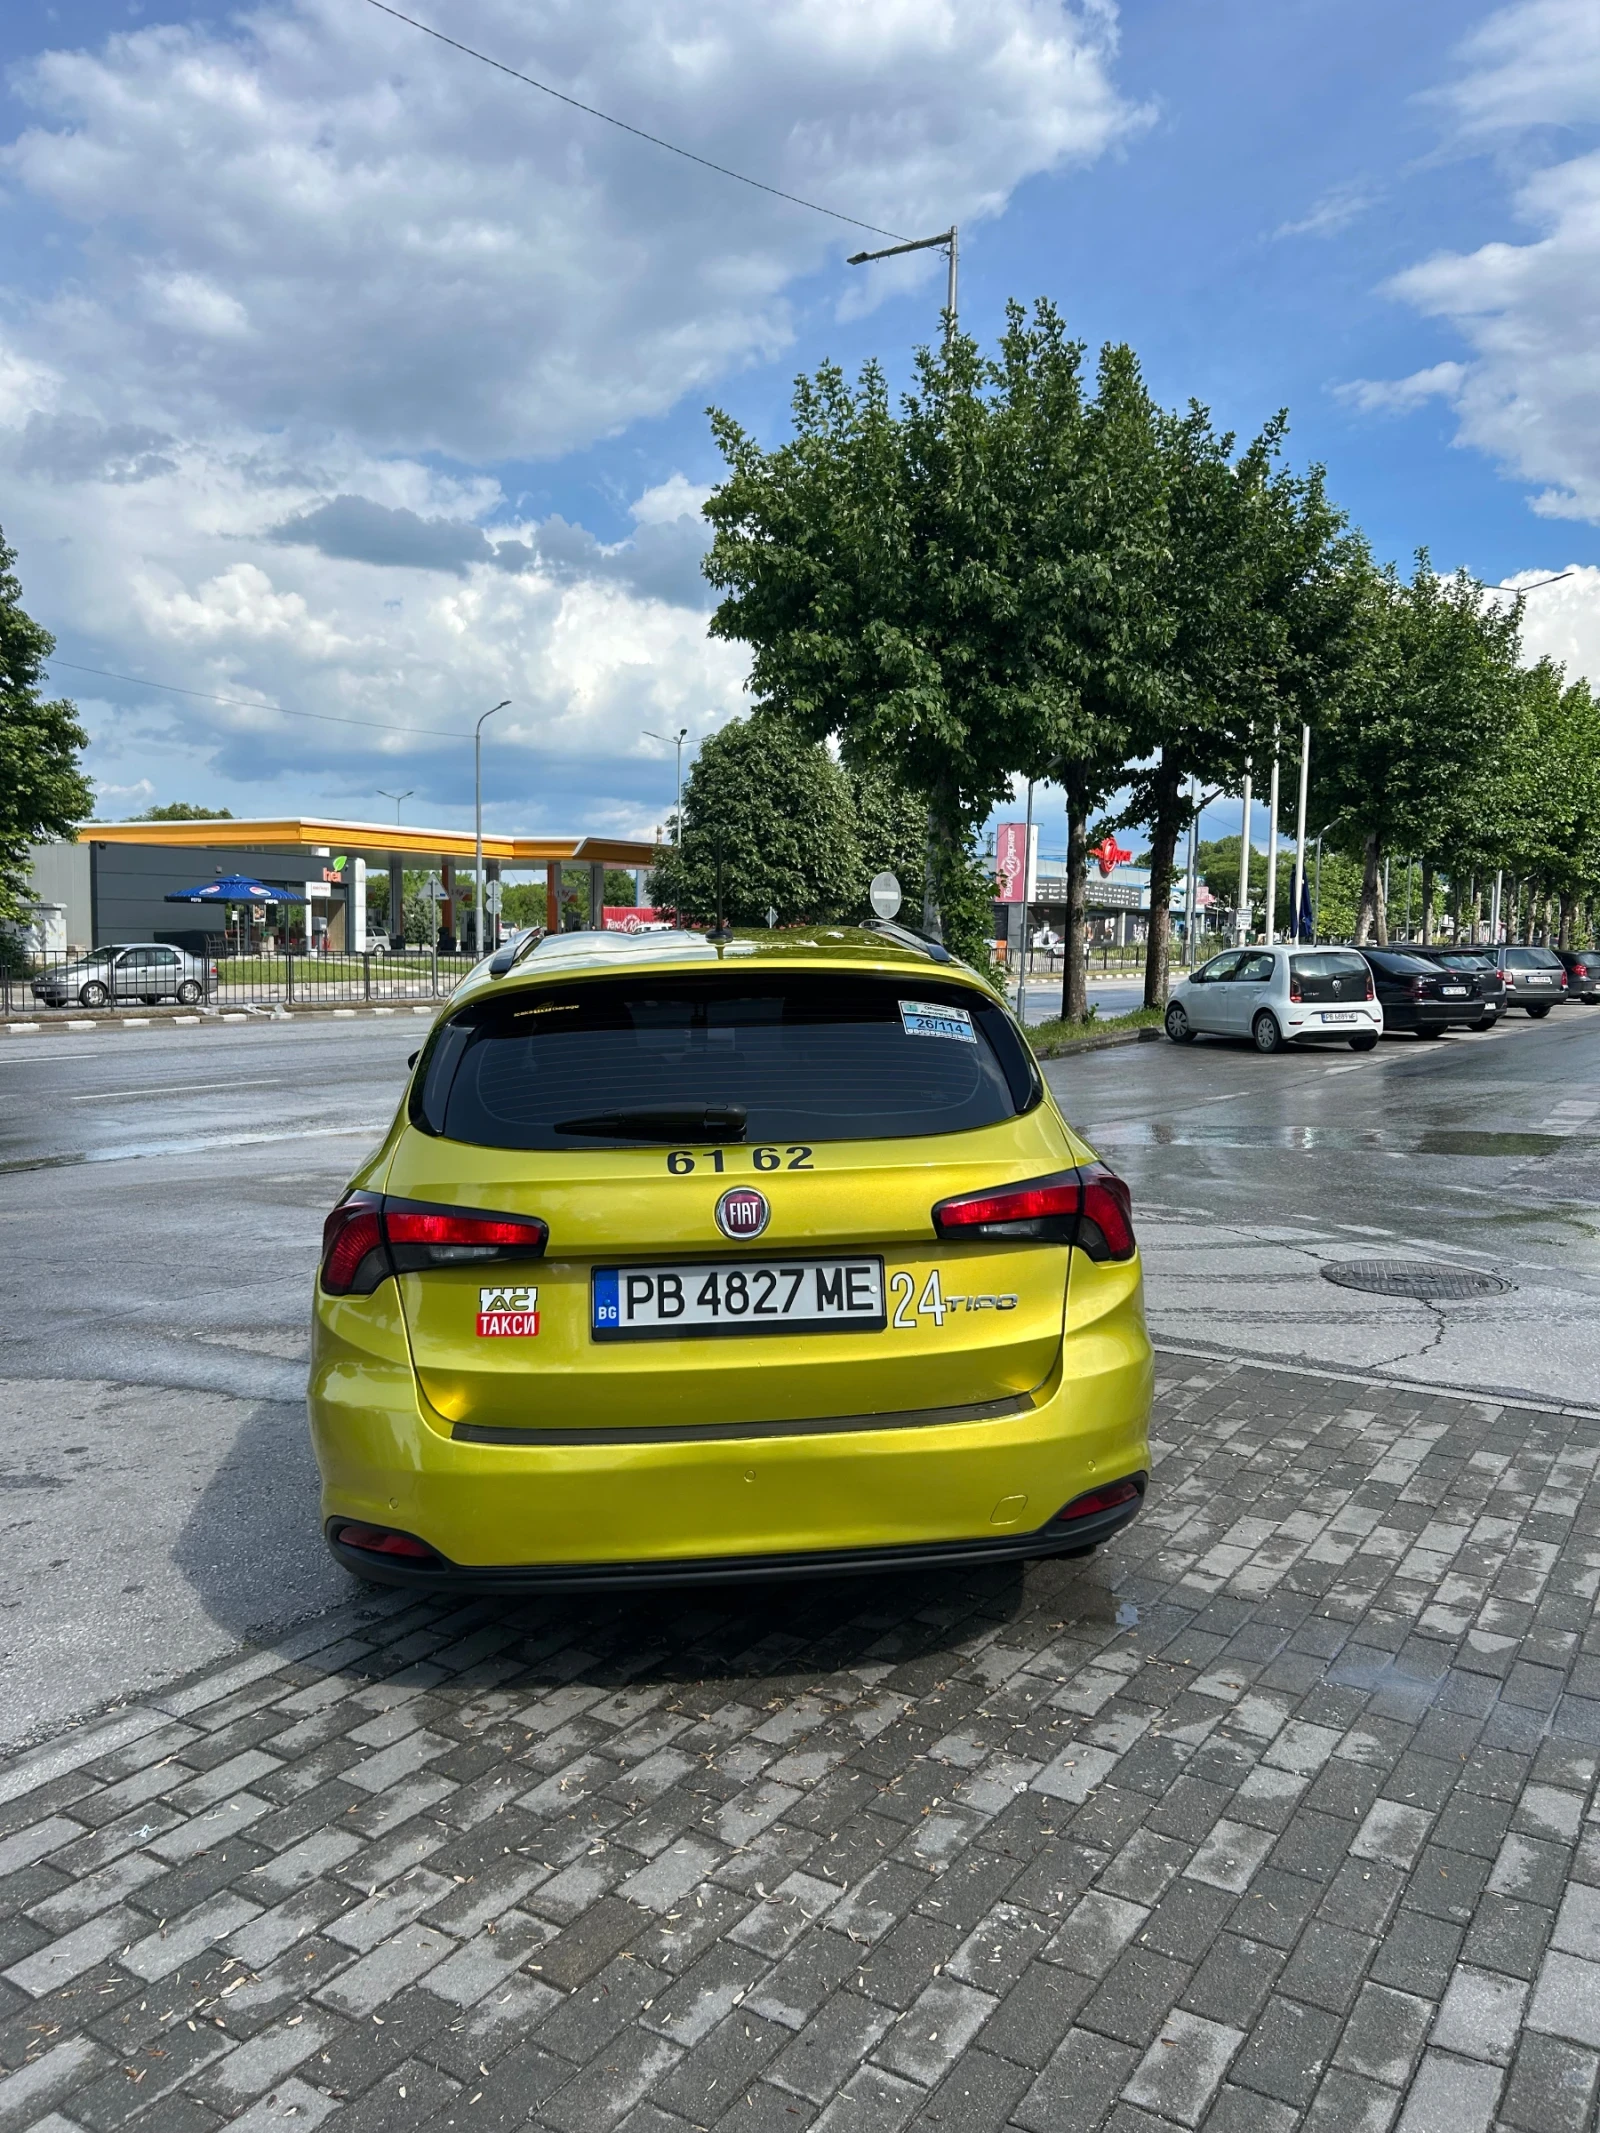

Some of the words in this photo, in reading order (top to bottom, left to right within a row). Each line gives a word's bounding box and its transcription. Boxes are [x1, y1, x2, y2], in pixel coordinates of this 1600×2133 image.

[916, 1018, 964, 1034] 26/114
[667, 1149, 725, 1175] 61
[752, 1146, 814, 1172] 62
[729, 1201, 759, 1226] FIAT
[626, 1273, 686, 1320] PB
[696, 1268, 804, 1316] 4827
[815, 1266, 874, 1312] ME
[889, 1269, 948, 1329] 24
[944, 1293, 1019, 1312] TIPO
[598, 1306, 617, 1320] BG
[480, 1315, 536, 1335] ТАКСИ
